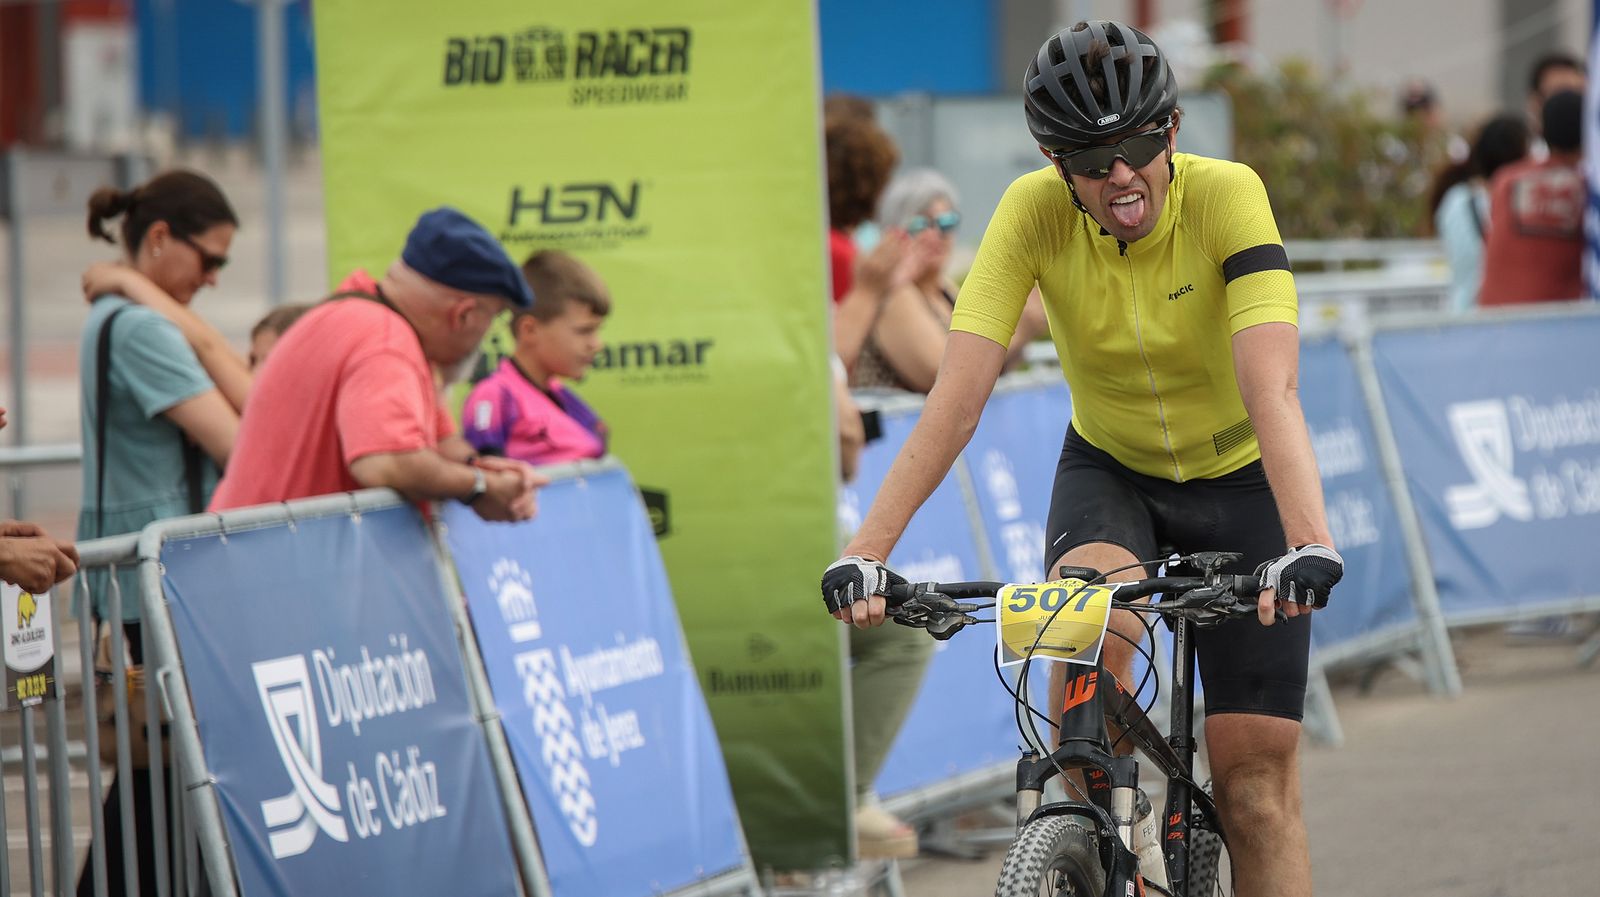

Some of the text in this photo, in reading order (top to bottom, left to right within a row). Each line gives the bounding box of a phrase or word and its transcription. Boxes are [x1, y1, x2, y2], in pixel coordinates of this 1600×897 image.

[573, 26, 692, 80] RACER
[509, 181, 640, 226] HSN
[1008, 587, 1101, 613] 507
[312, 633, 437, 737] Diputación
[346, 745, 448, 839] de Cádiz
